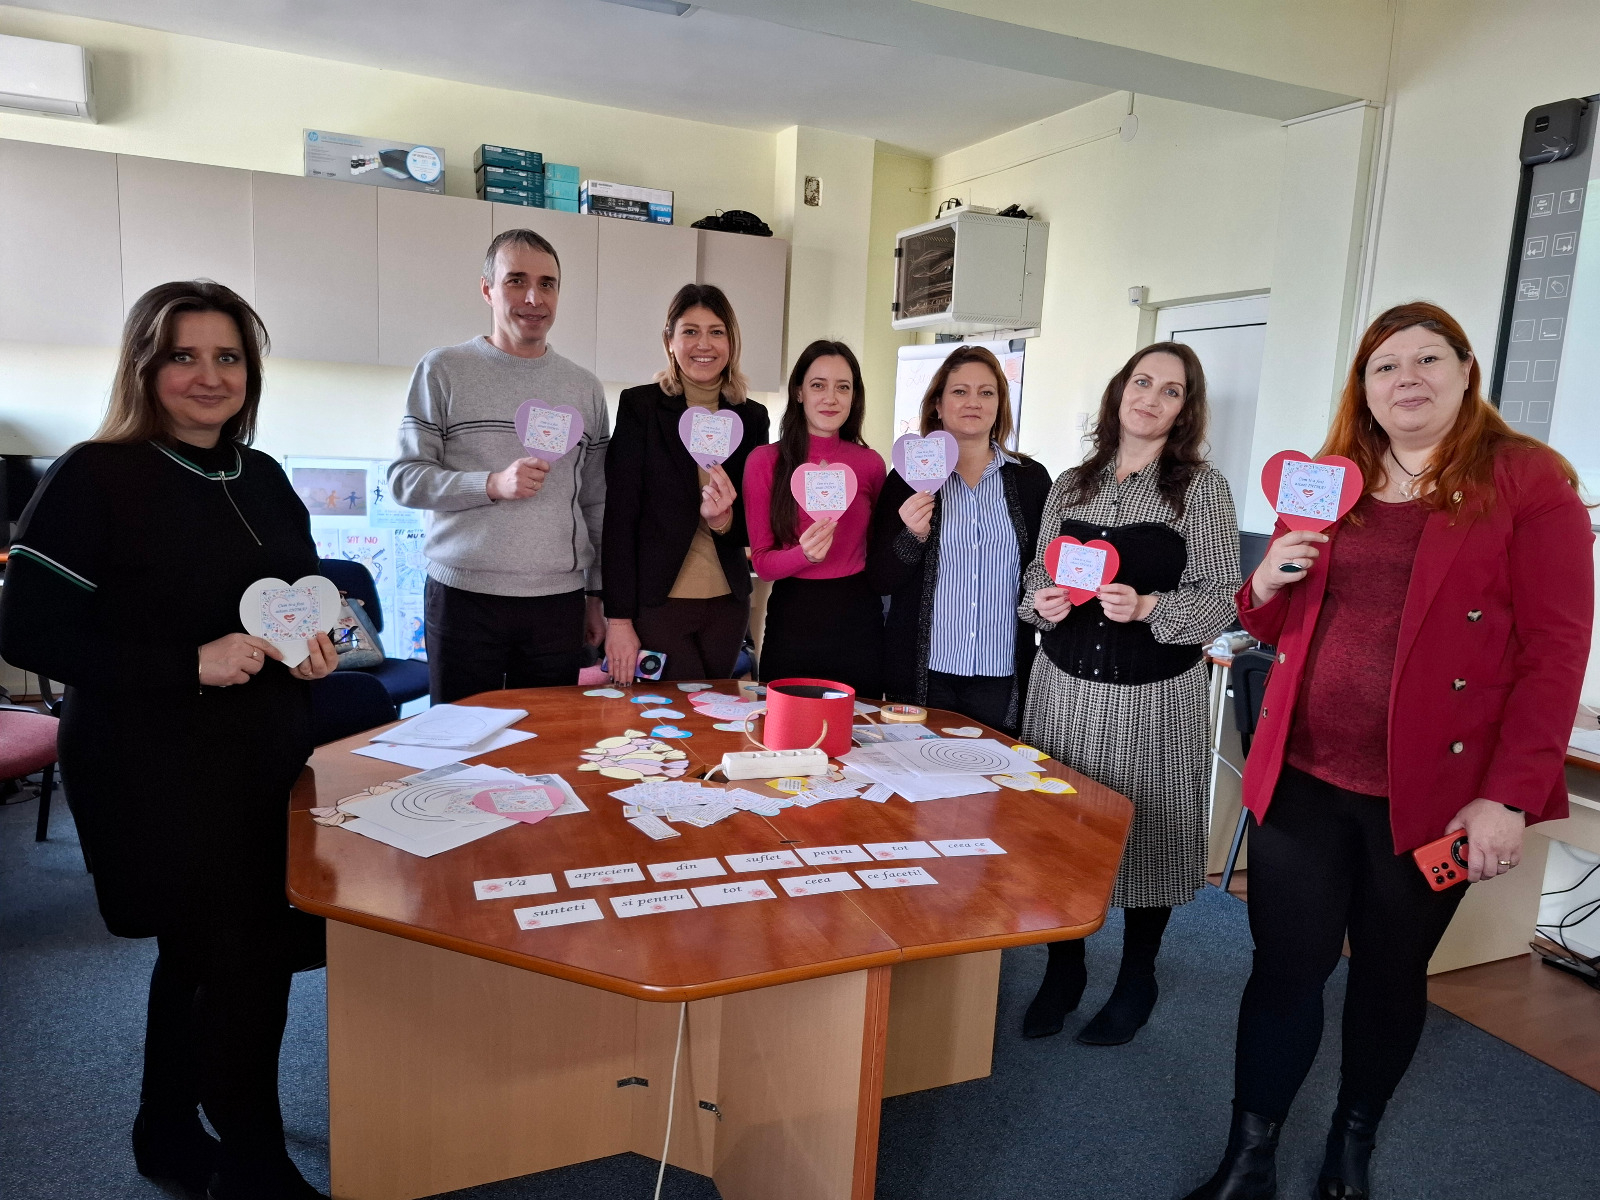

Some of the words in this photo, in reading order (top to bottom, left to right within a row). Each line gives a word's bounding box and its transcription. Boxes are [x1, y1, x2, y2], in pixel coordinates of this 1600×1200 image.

[364, 536, 379, 545] NO
[813, 847, 853, 858] pentru
[745, 853, 782, 864] suflet
[573, 866, 635, 880] apreciem
[675, 863, 698, 872] din
[867, 872, 880, 880] ce
[881, 868, 923, 881] faceti!
[504, 879, 527, 888] Vă
[804, 876, 832, 886] ceea
[723, 886, 743, 895] tot
[621, 897, 634, 907] si
[636, 892, 685, 908] pentru
[531, 902, 587, 918] sunteti
